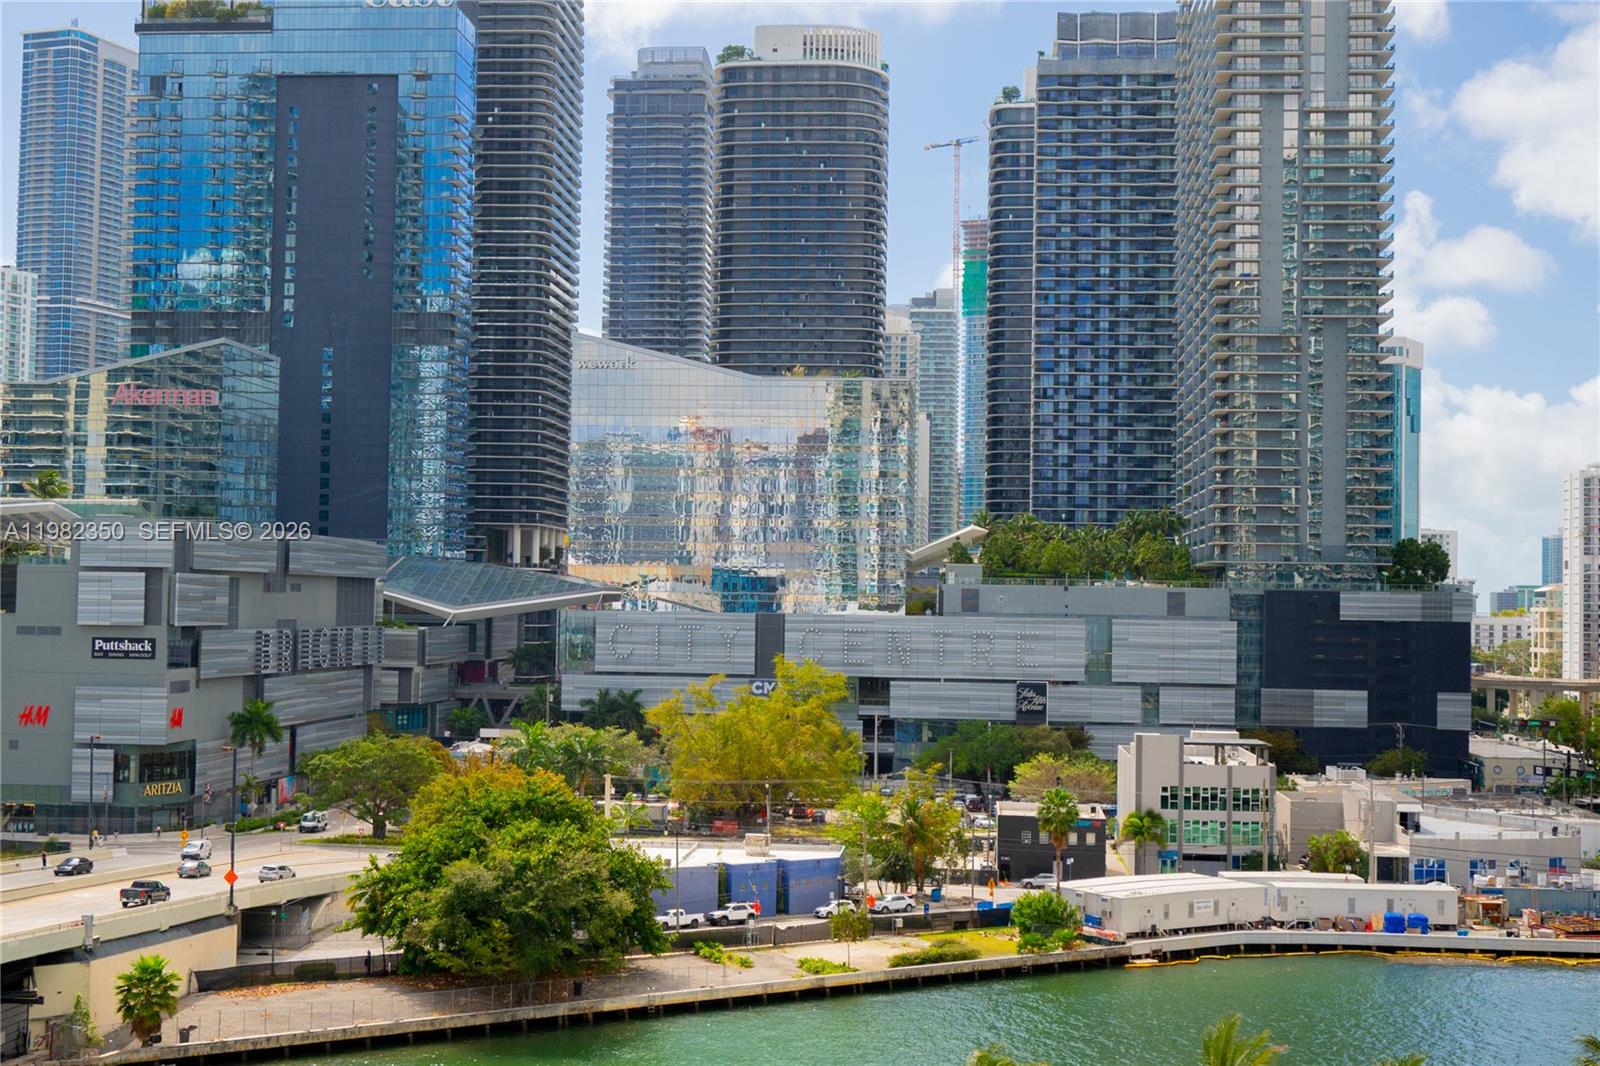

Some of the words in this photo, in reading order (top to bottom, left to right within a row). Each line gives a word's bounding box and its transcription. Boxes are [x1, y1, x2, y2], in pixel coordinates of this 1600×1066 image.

[112, 384, 218, 406] Akerman
[95, 640, 152, 651] Puttshack
[609, 624, 741, 662] CITY
[799, 627, 1040, 667] CENTRE
[144, 782, 182, 796] ARITZIA
